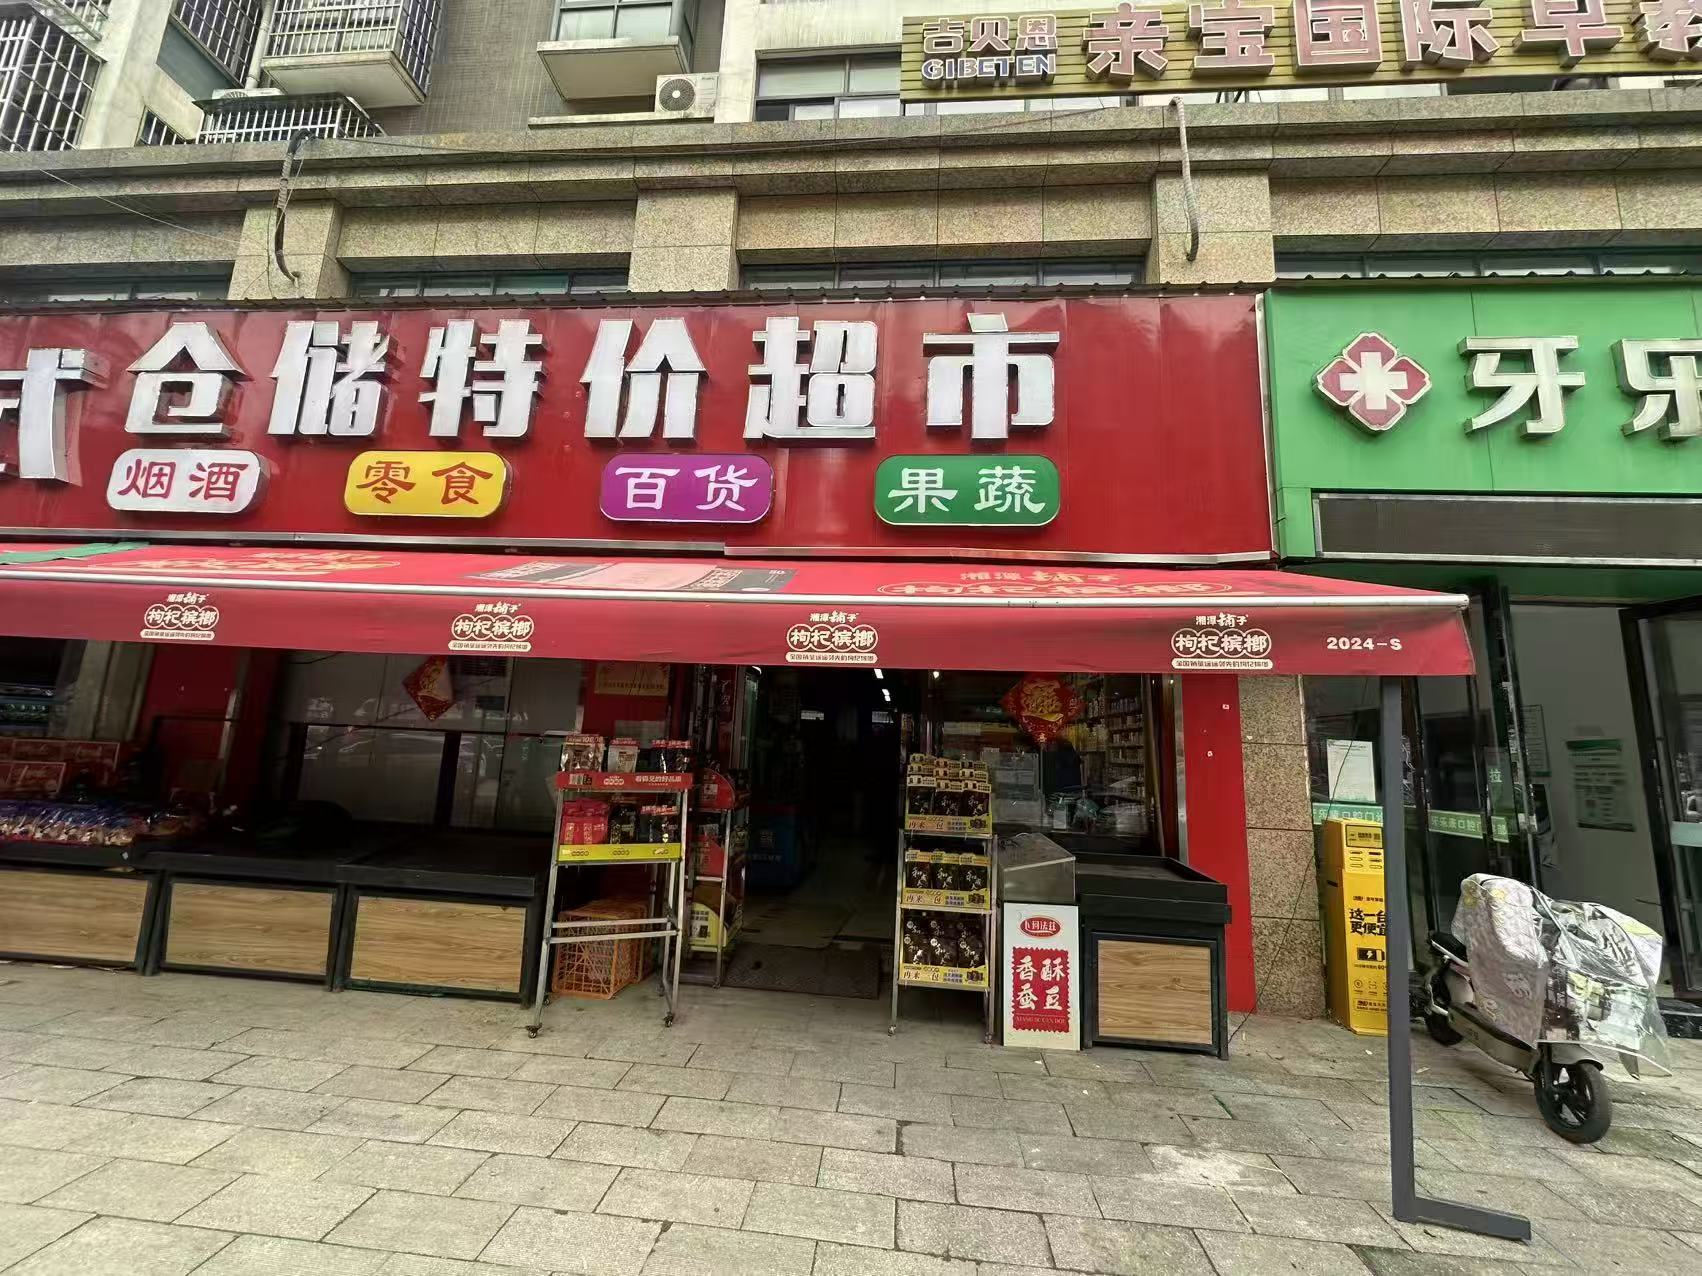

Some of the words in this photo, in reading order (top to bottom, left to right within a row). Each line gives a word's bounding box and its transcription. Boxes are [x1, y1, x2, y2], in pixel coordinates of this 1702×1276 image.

[923, 14, 1058, 52] 吉贝恩
[922, 54, 1056, 80] GIBETEN
[1464, 335, 1702, 440] 牙乐
[117, 459, 249, 502] 烟酒
[355, 461, 494, 504] 零食
[615, 464, 759, 512] 百货
[888, 465, 1046, 514] 果蔬
[147, 608, 217, 626] 枸杞槟榔
[455, 619, 531, 637] 枸杞槟榔
[790, 628, 875, 647] 枸杞槟榔
[1175, 634, 1268, 653] 枸杞槟榔
[1326, 637, 1403, 651] 2024-S
[1016, 955, 1066, 982] 香酥
[1016, 982, 1064, 1011] 蚕豆
